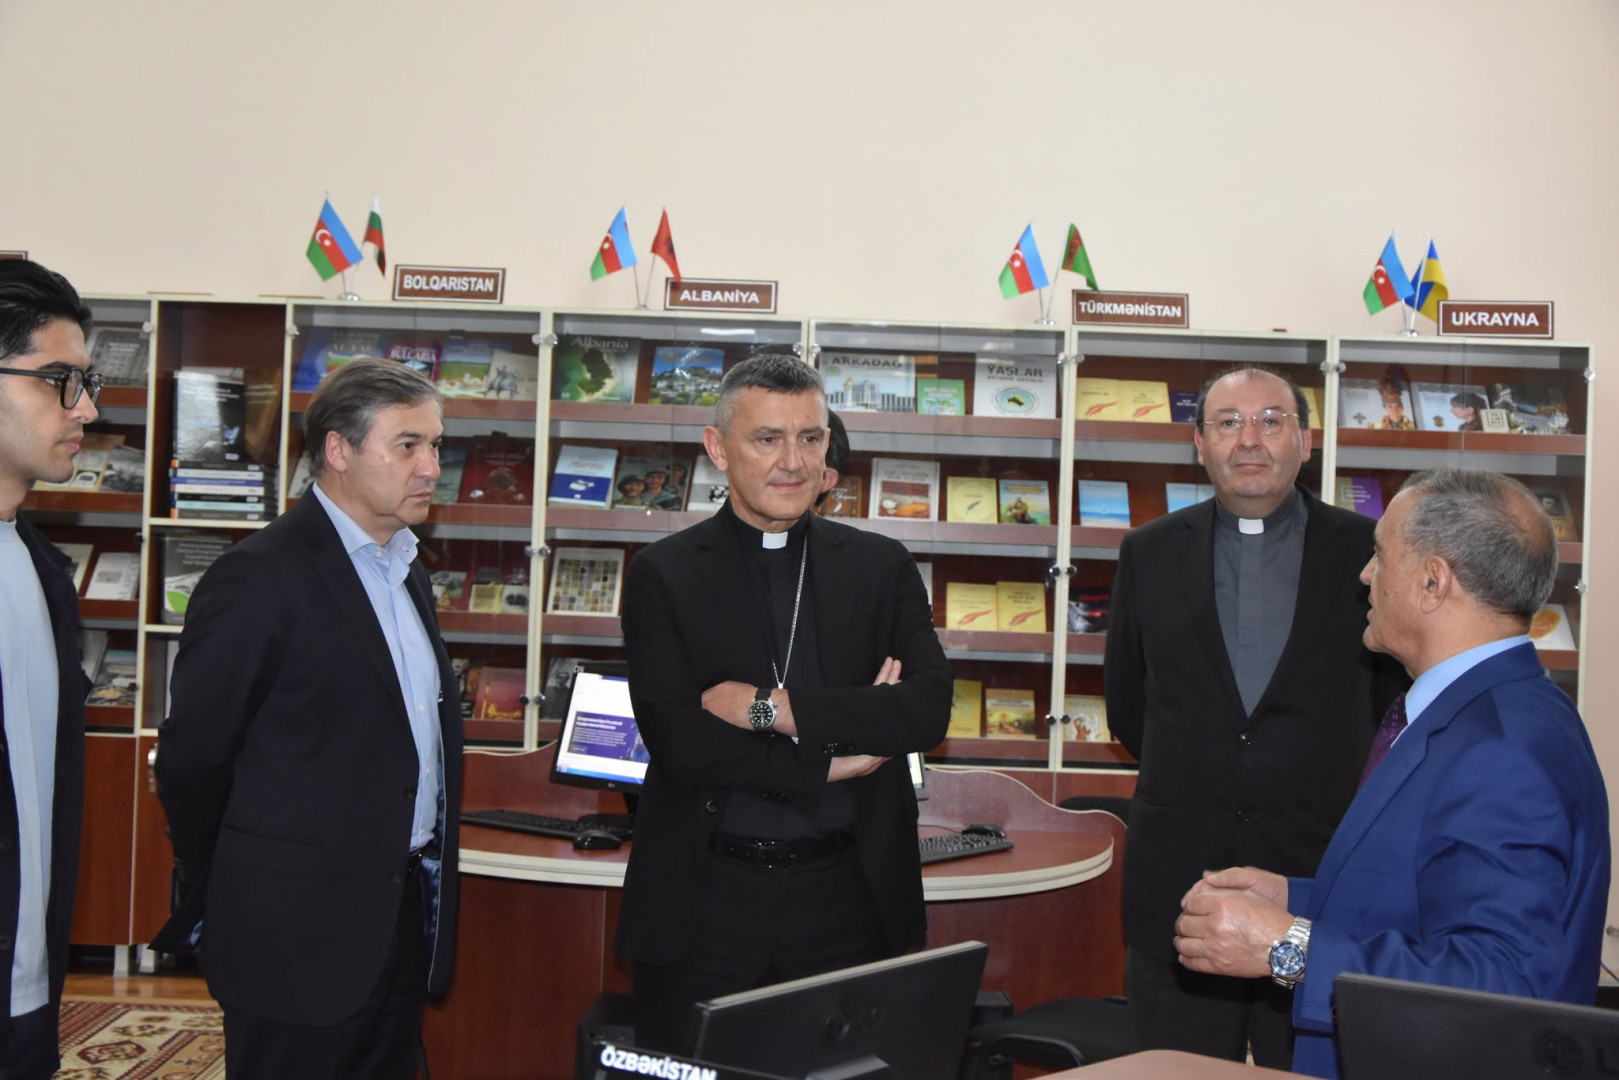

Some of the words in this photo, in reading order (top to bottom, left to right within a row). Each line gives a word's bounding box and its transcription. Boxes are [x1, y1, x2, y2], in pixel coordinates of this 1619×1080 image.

[403, 274, 494, 292] BOLQARISTAN
[680, 289, 760, 304] ALBANİYA
[1079, 300, 1182, 318] TÜRKMƏNİSTAN
[1451, 312, 1540, 326] UKRAYNA
[571, 336, 629, 349] Albania
[600, 1045, 717, 1080] ÖZBƏKİSTAN
